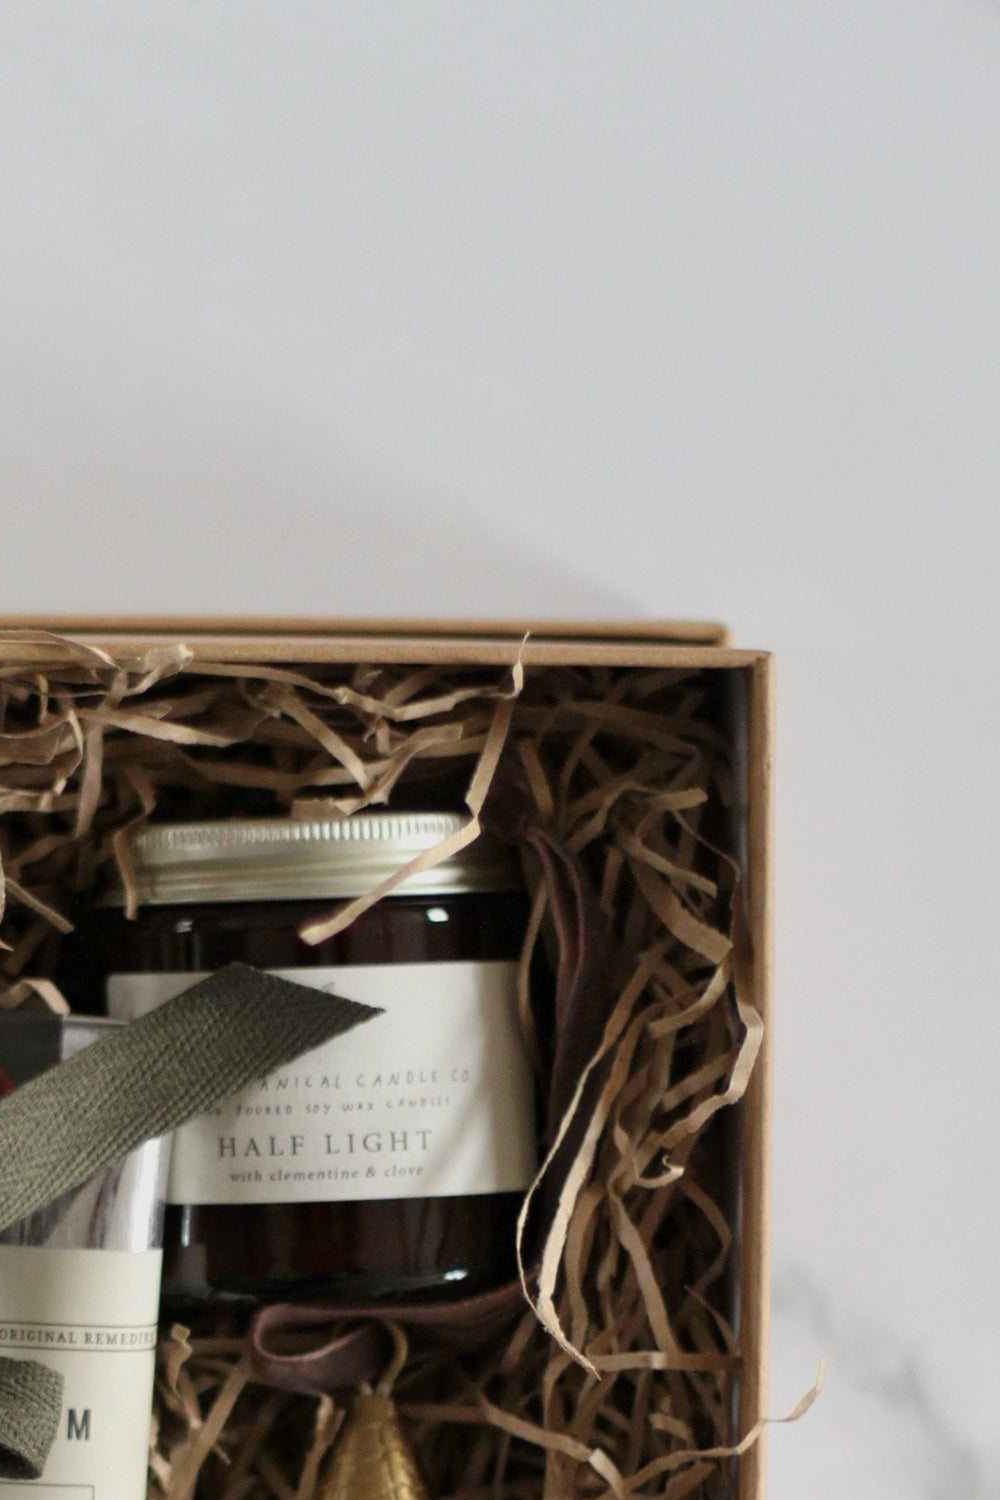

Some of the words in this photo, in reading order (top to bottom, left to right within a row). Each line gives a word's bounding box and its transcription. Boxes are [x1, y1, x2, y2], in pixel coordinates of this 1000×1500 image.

[356, 1069, 438, 1088] CANDLE
[236, 1103, 293, 1116] POURED
[306, 1103, 331, 1116] SOY
[342, 1101, 374, 1112] WAX
[218, 1134, 305, 1158] HALF
[325, 1129, 432, 1155] LIGHT
[230, 1170, 263, 1183] with
[269, 1166, 360, 1182] clementine
[365, 1165, 376, 1179] &
[384, 1164, 424, 1178] clove
